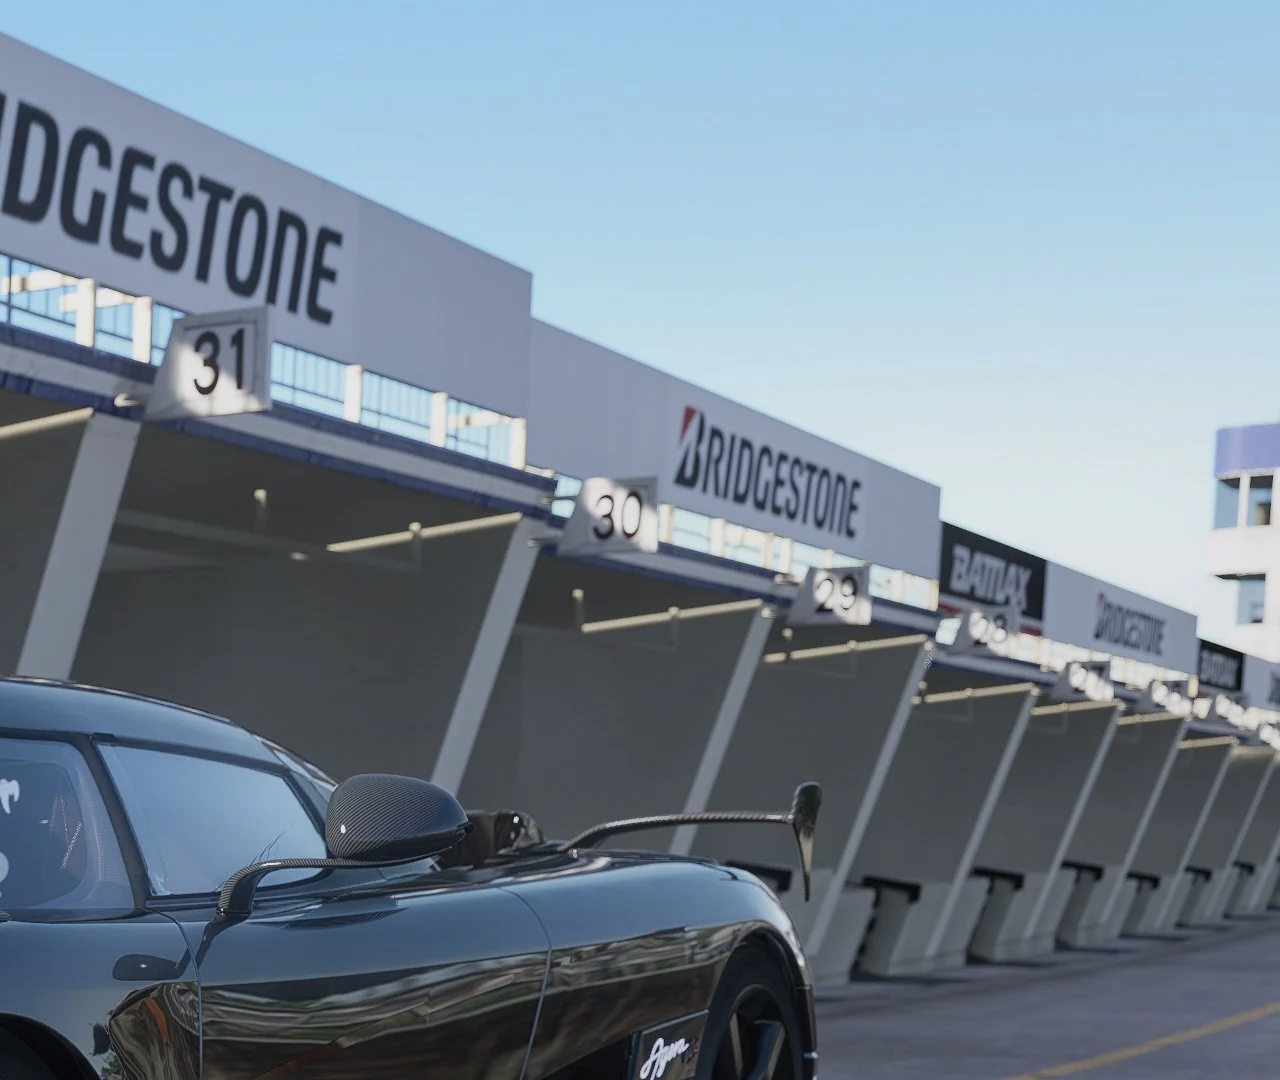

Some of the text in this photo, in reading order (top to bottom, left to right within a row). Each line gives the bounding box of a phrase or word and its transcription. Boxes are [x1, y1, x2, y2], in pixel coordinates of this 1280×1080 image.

[193, 327, 245, 395] 31
[674, 405, 862, 538] BRIDGESTONE
[593, 491, 642, 540] 30
[815, 575, 859, 614] 29
